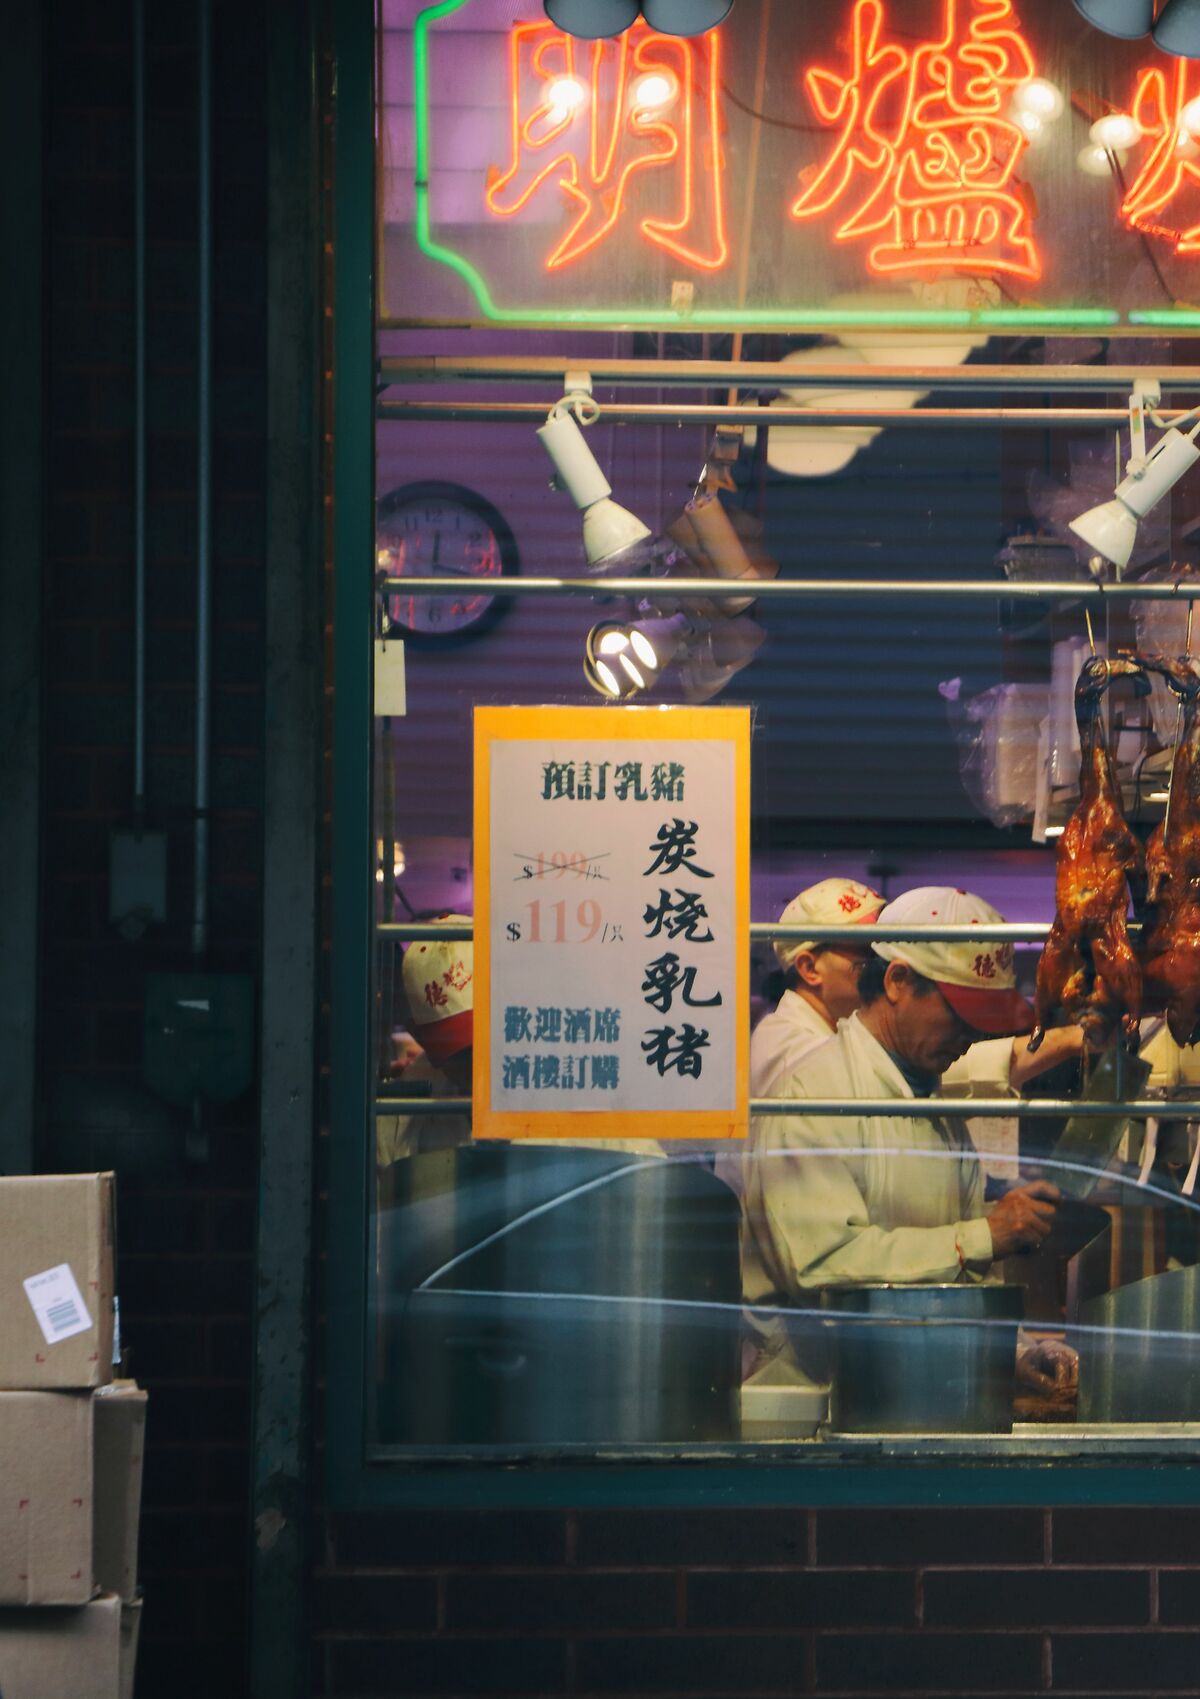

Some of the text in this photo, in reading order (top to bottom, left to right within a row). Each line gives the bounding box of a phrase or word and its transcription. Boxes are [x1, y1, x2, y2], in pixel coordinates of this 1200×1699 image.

[424, 509, 443, 523] 12
[540, 760, 686, 802] 預訂乳豬
[503, 1005, 622, 1044] 歡迎酒席
[502, 1054, 620, 1090] 酒樓訂購
